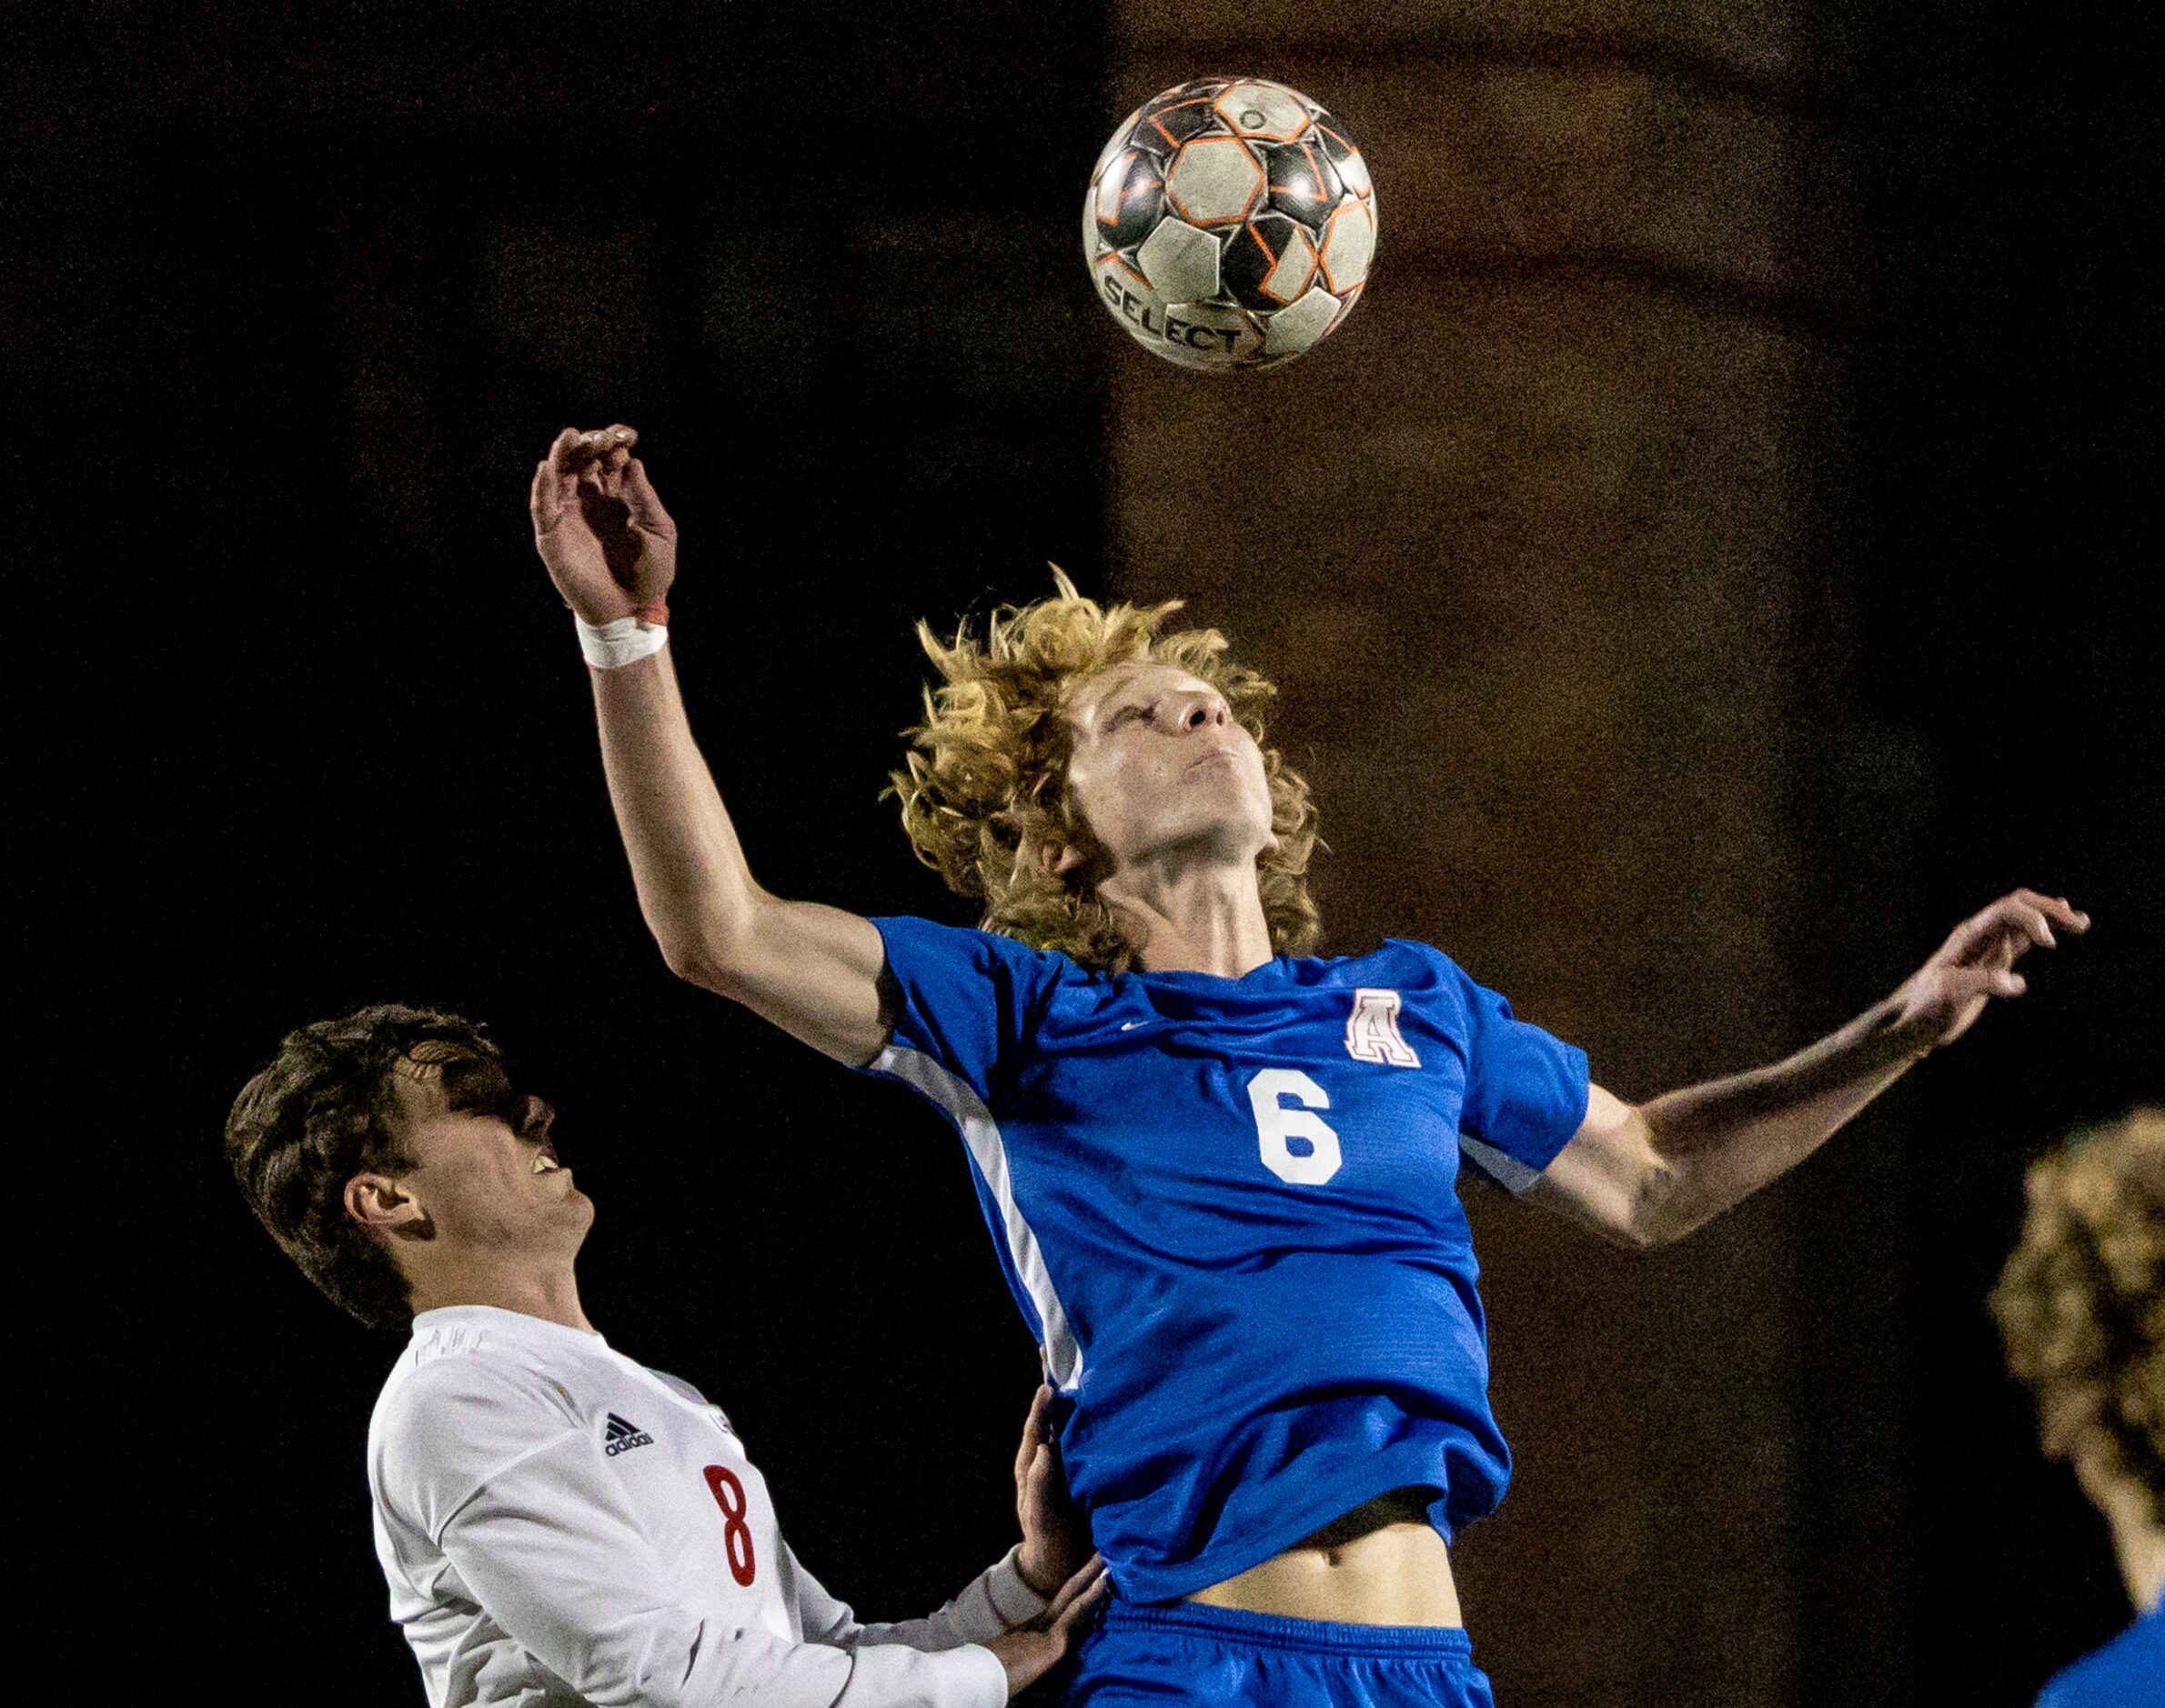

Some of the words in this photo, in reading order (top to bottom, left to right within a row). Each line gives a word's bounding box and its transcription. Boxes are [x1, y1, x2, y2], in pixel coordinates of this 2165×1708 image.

[1104, 276, 1242, 353] SELECT
[1344, 988, 1422, 1068] A
[1247, 1069, 1342, 1185] 6
[605, 1432, 654, 1456] adidas
[703, 1465, 755, 1587] 8
